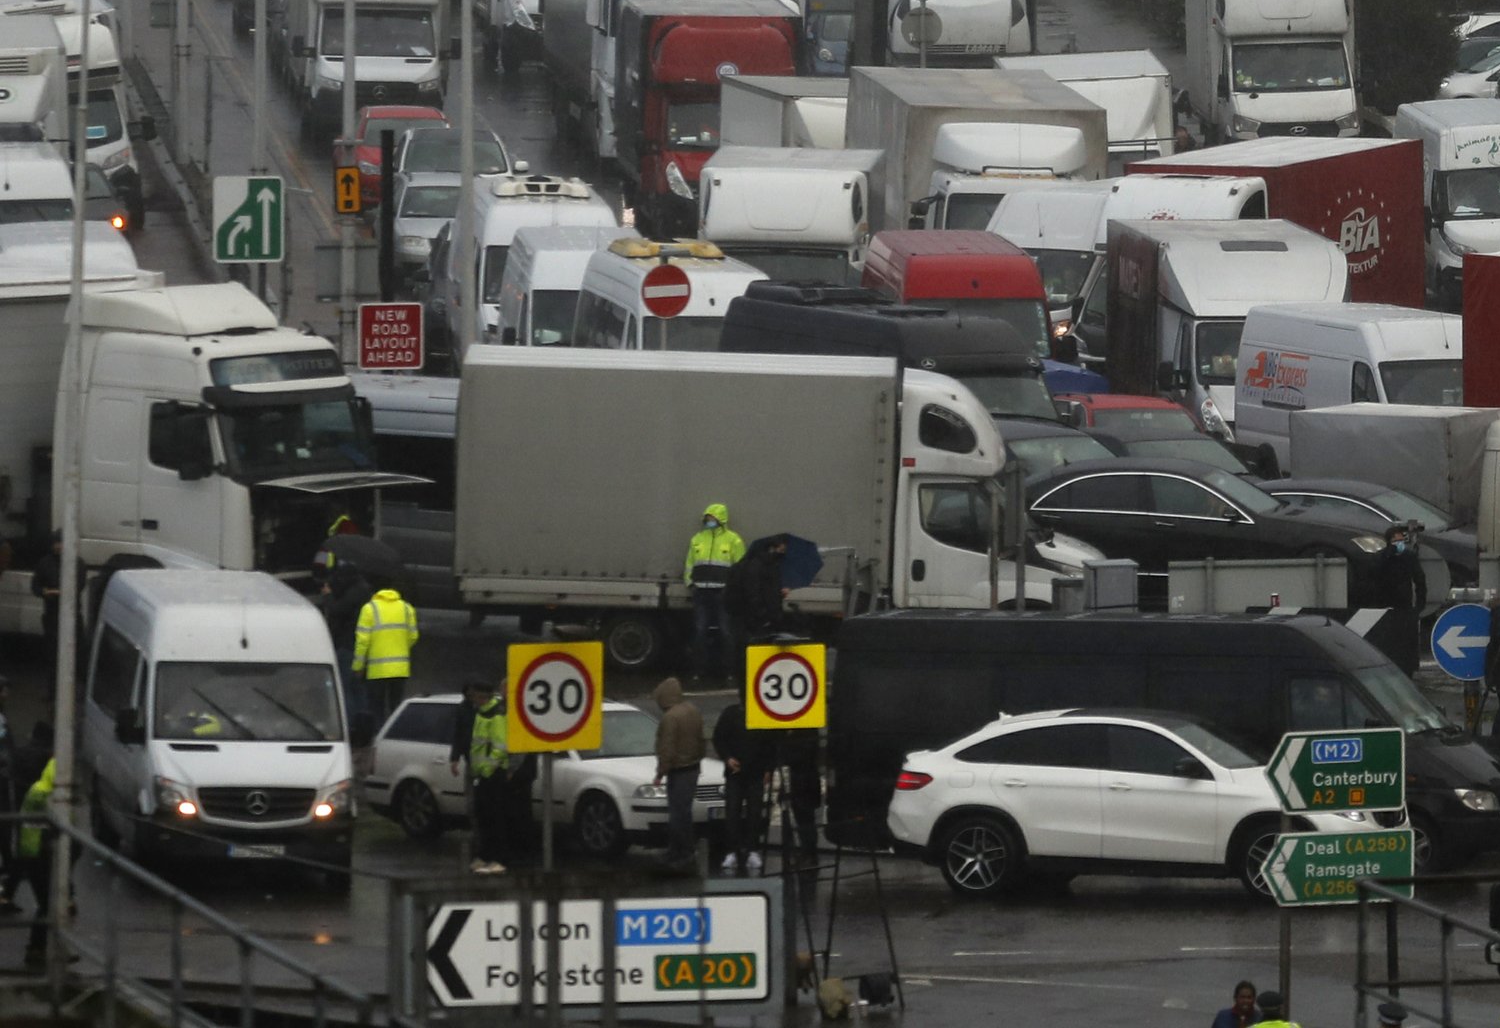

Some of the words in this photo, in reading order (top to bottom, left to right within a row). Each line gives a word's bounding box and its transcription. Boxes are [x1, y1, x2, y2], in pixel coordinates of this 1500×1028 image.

[375, 310, 408, 322] NEW
[371, 323, 410, 335] ROAD
[365, 337, 418, 349] LAYOUT
[366, 351, 415, 363] AHEAD
[764, 673, 808, 701] 30
[528, 678, 584, 715] 30
[1312, 771, 1398, 787] Canterbury
[1312, 791, 1336, 805] A2
[1305, 842, 1340, 856] Deal
[1345, 836, 1407, 854] (A258)
[1305, 861, 1381, 879] Ramsgate
[1304, 881, 1356, 898] (A256
[658, 956, 754, 986] (A20)
